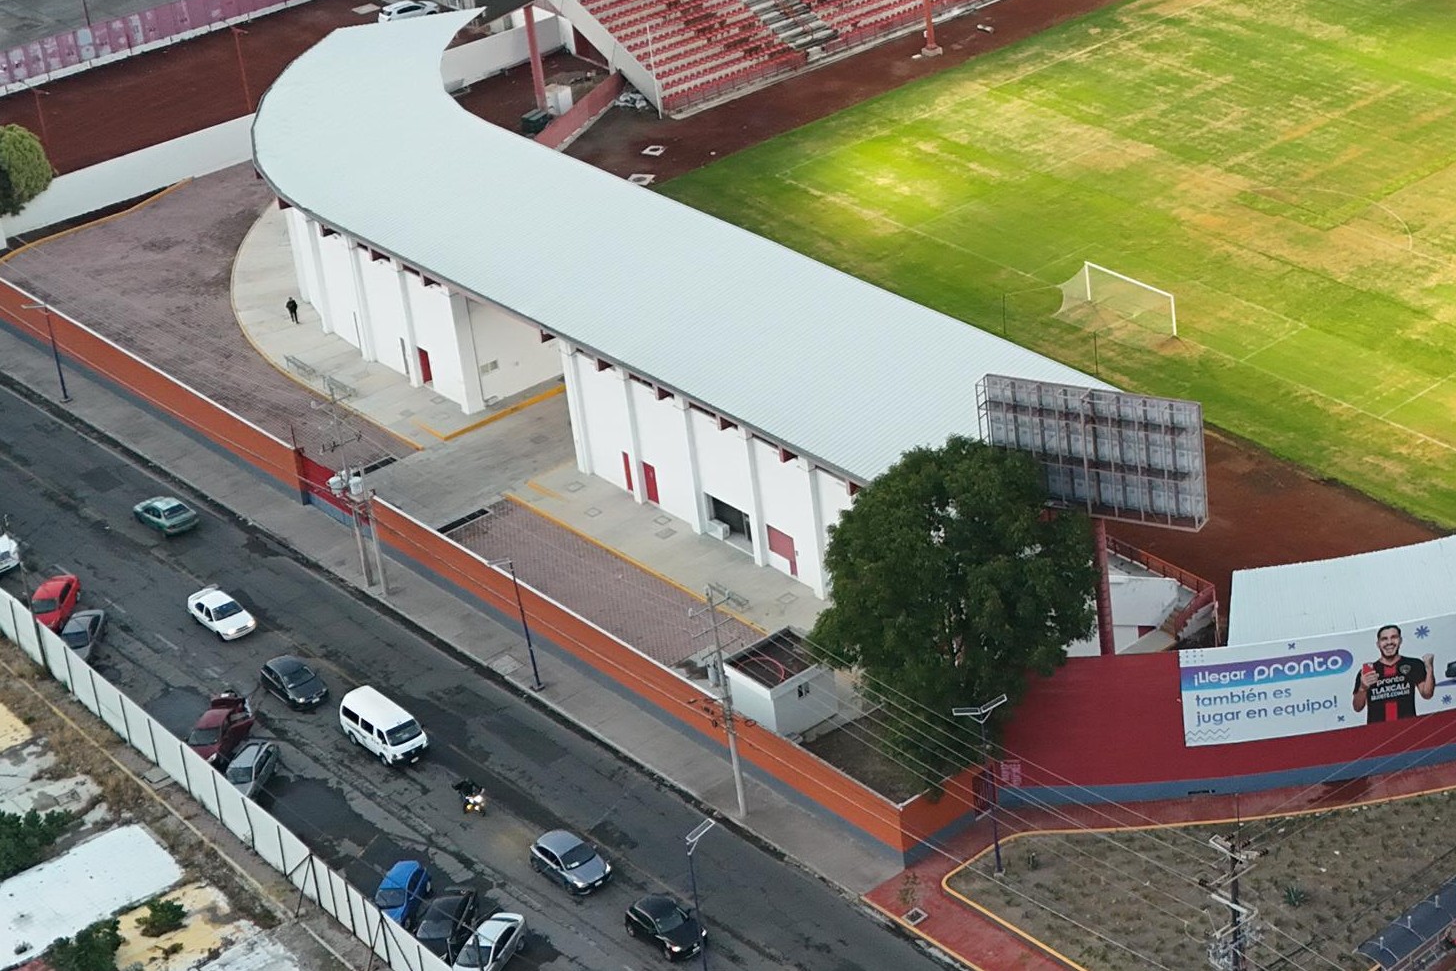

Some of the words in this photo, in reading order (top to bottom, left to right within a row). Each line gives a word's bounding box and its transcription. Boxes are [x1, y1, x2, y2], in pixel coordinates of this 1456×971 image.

[1194, 669, 1247, 687] ¡Llegar
[1254, 656, 1343, 682] pronto
[1376, 675, 1405, 687] pronto
[1196, 688, 1268, 707] también
[1273, 687, 1292, 699] es
[1372, 682, 1410, 696] TLAXCALA
[1196, 710, 1241, 727] jugar
[1246, 706, 1268, 719] en
[1273, 695, 1338, 717] equipo!
